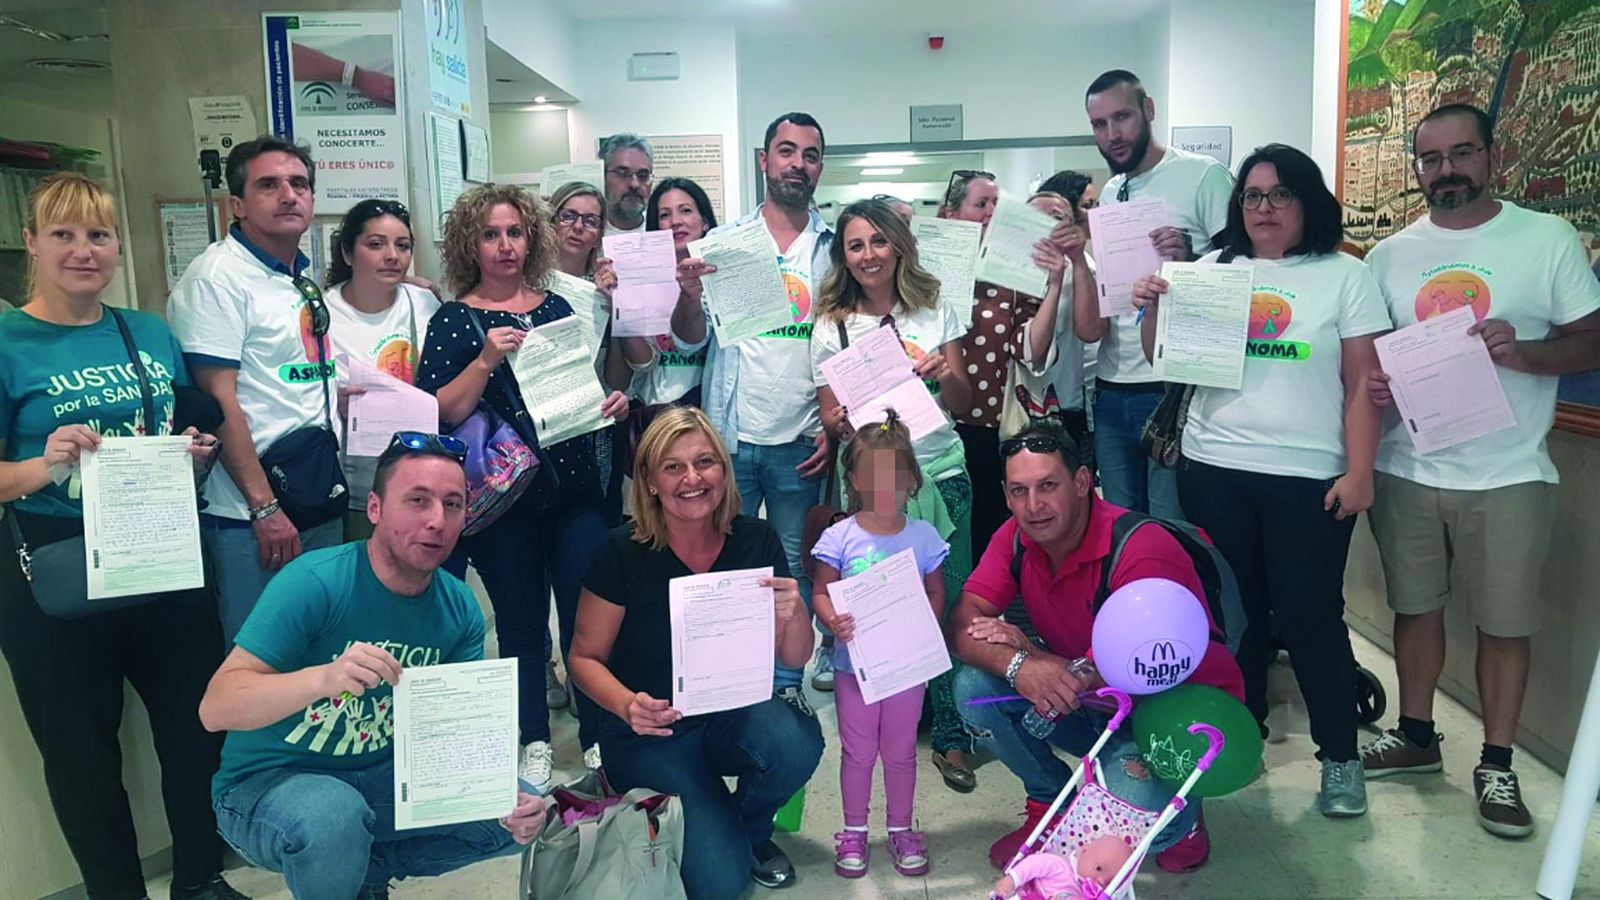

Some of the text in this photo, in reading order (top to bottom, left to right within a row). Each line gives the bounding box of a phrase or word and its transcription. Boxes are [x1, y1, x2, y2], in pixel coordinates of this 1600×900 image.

[317, 129, 386, 137] NECESITAMOS
[318, 140, 385, 148] CONOCERTE...
[1181, 142, 1222, 152] Seguridad
[328, 161, 356, 170] ERES
[1246, 342, 1298, 358] NOMA
[53, 380, 173, 418] por la SANDA
[1135, 656, 1190, 679] happy
[1147, 675, 1178, 686] meal
